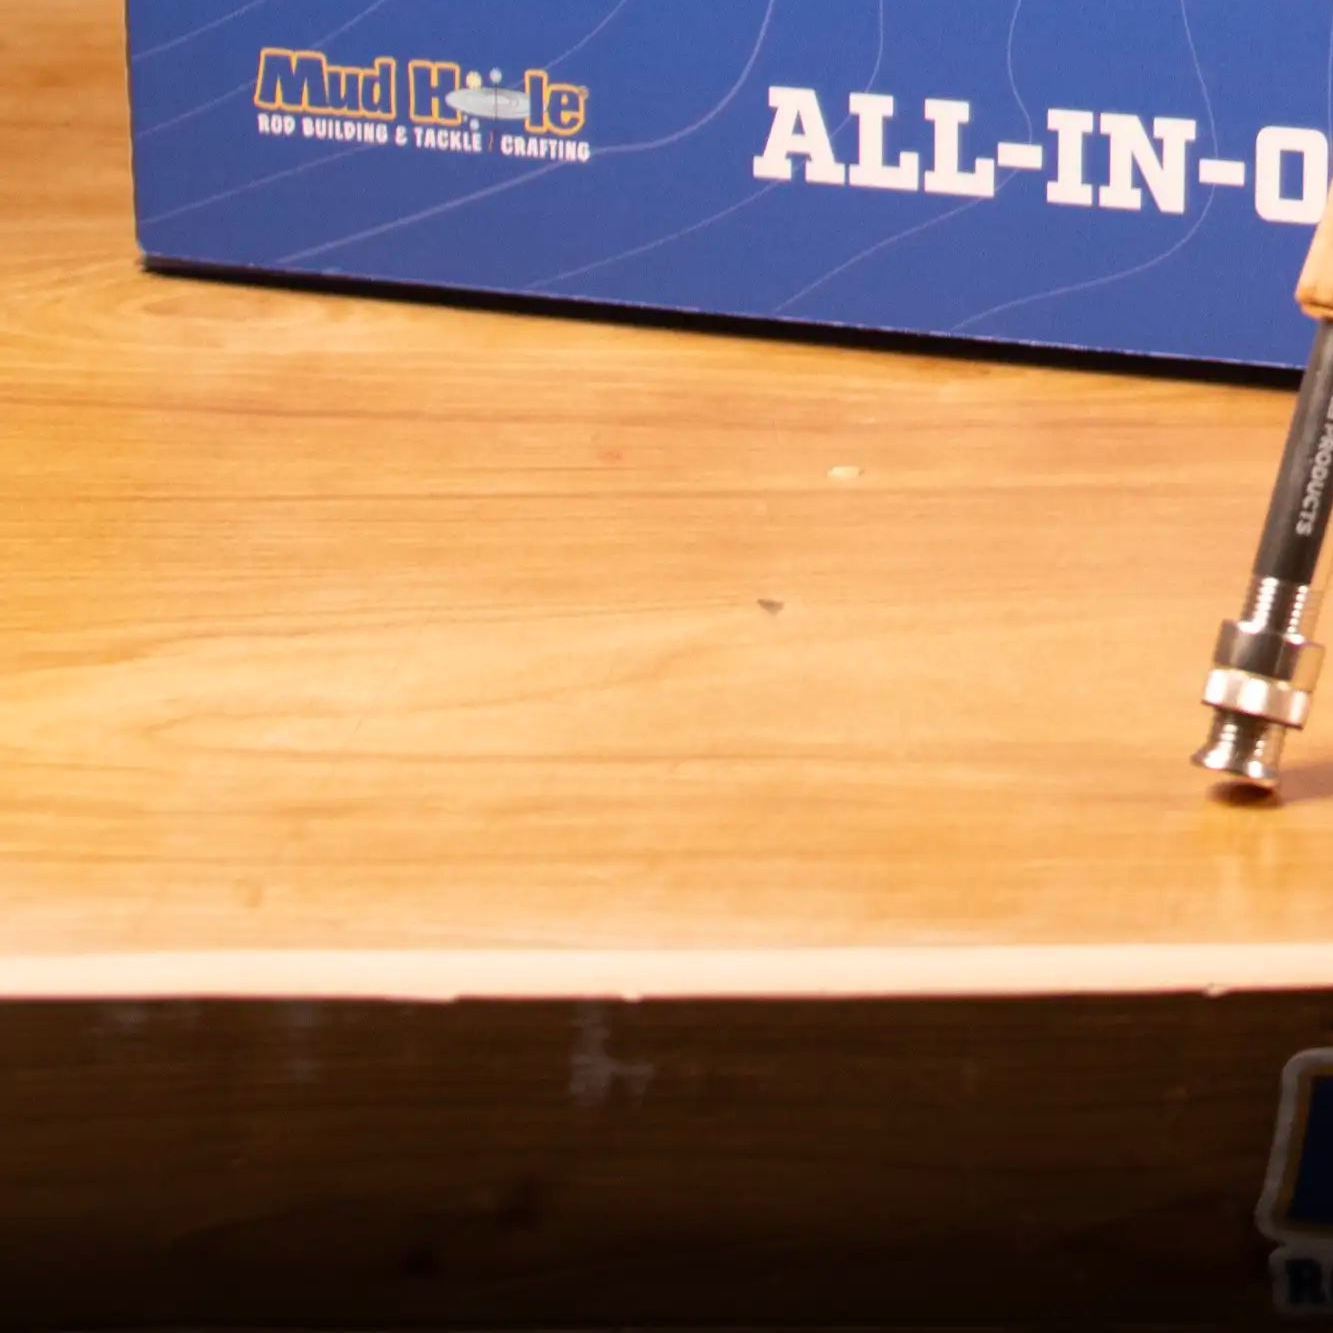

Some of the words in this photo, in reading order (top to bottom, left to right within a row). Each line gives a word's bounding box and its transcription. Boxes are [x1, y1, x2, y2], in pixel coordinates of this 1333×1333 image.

[254, 48, 396, 120] Mud
[257, 113, 295, 136] ROD
[302, 117, 388, 145] BUILDING
[414, 127, 483, 154] TACKLE
[501, 135, 591, 163] CRAFTING
